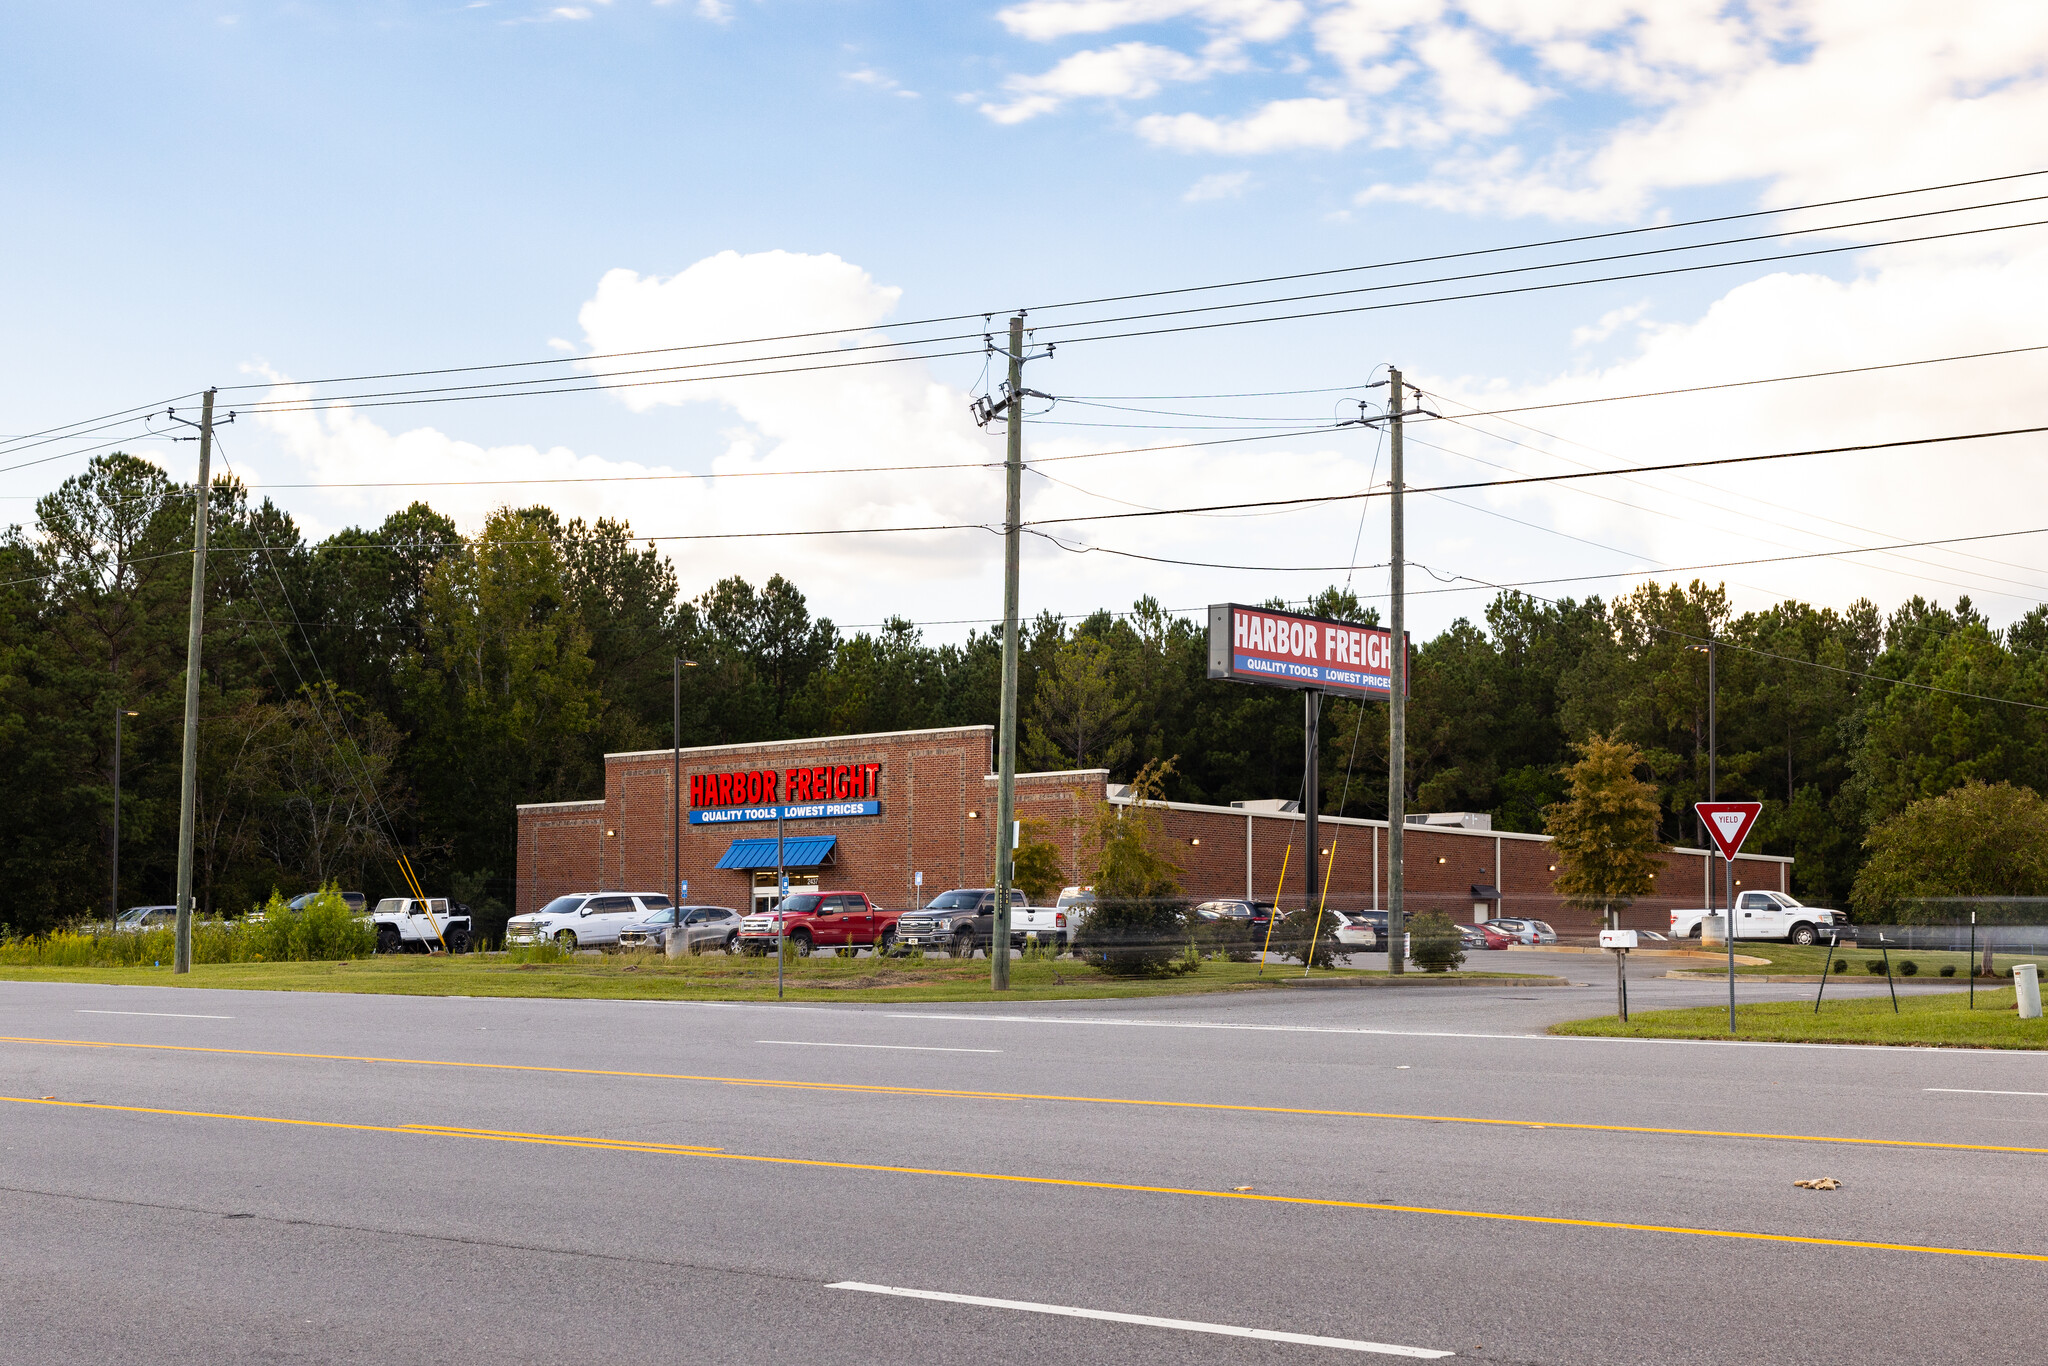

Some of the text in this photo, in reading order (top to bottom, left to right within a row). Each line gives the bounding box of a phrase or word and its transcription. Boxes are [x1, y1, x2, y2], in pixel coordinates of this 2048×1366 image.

[1234, 613, 1406, 669] HARBOR FREIGH
[1247, 659, 1287, 673] QUALITY
[1288, 665, 1319, 678] TOOLS
[1326, 669, 1361, 684] LOWEST
[690, 763, 881, 807] HARBOR FREIGHT
[702, 803, 864, 822] QUALITY TOOLS LOWEST PRICES
